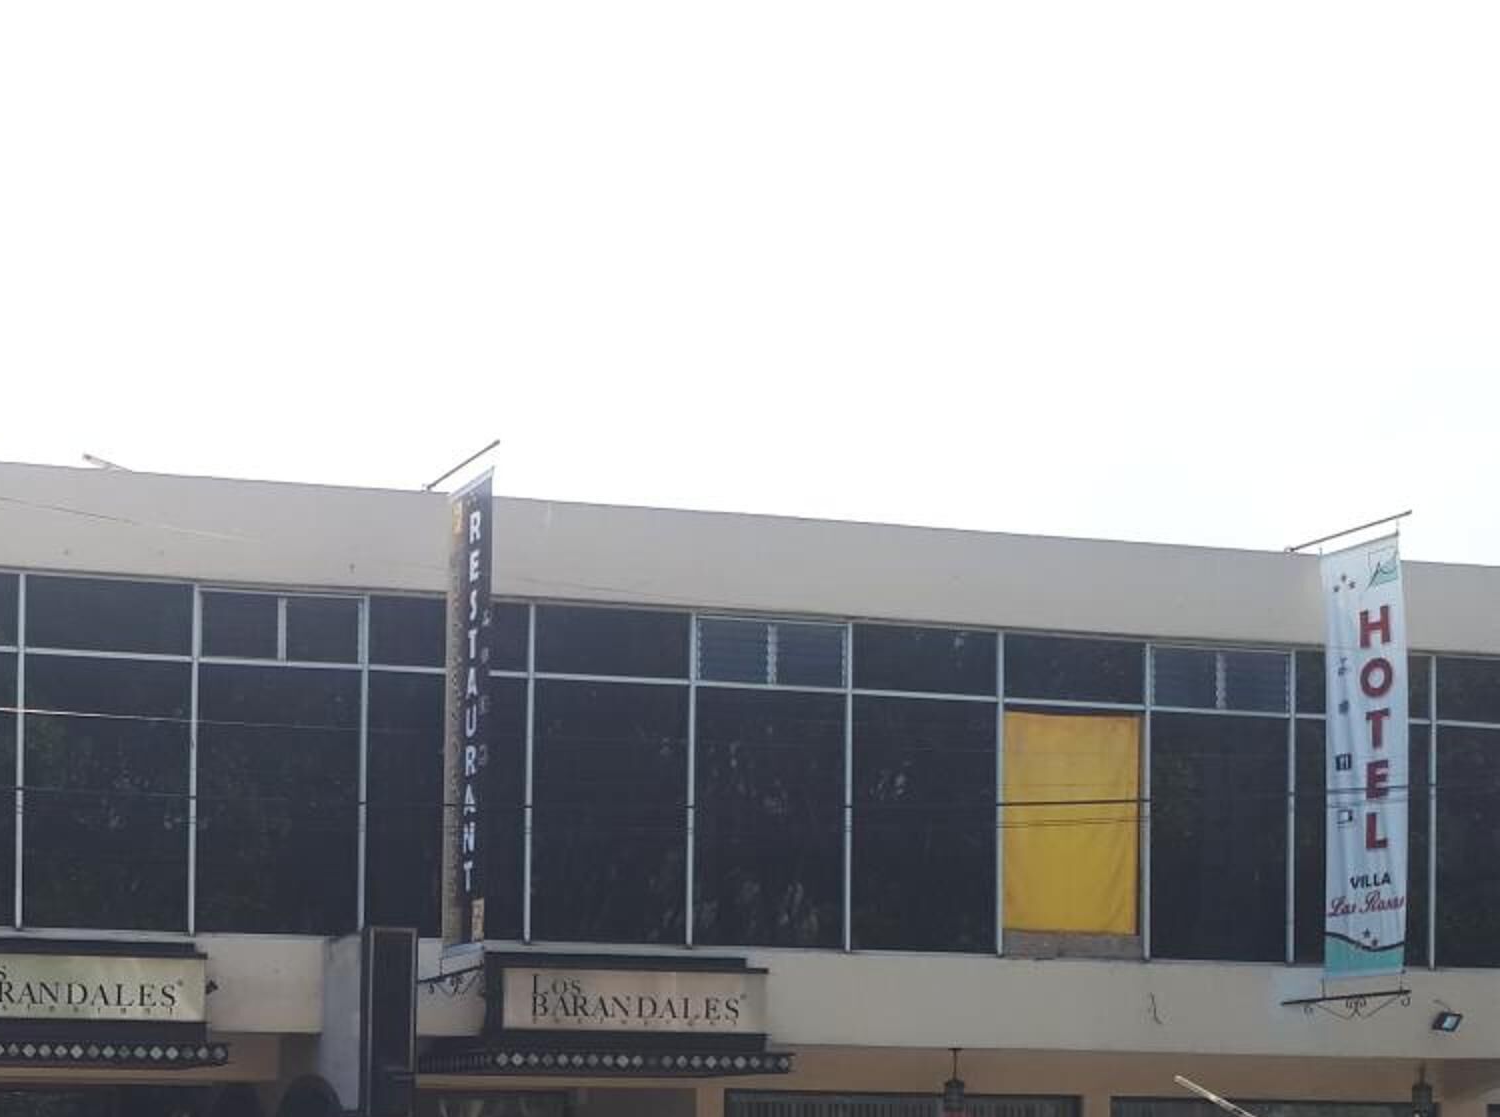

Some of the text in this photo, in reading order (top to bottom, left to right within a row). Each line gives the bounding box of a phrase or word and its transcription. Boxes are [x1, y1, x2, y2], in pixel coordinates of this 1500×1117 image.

[462, 511, 481, 892] RESTAURANT
[1358, 604, 1394, 851] HOTEL
[1350, 872, 1391, 890] VILLA
[532, 994, 740, 1021] BARANDALES
